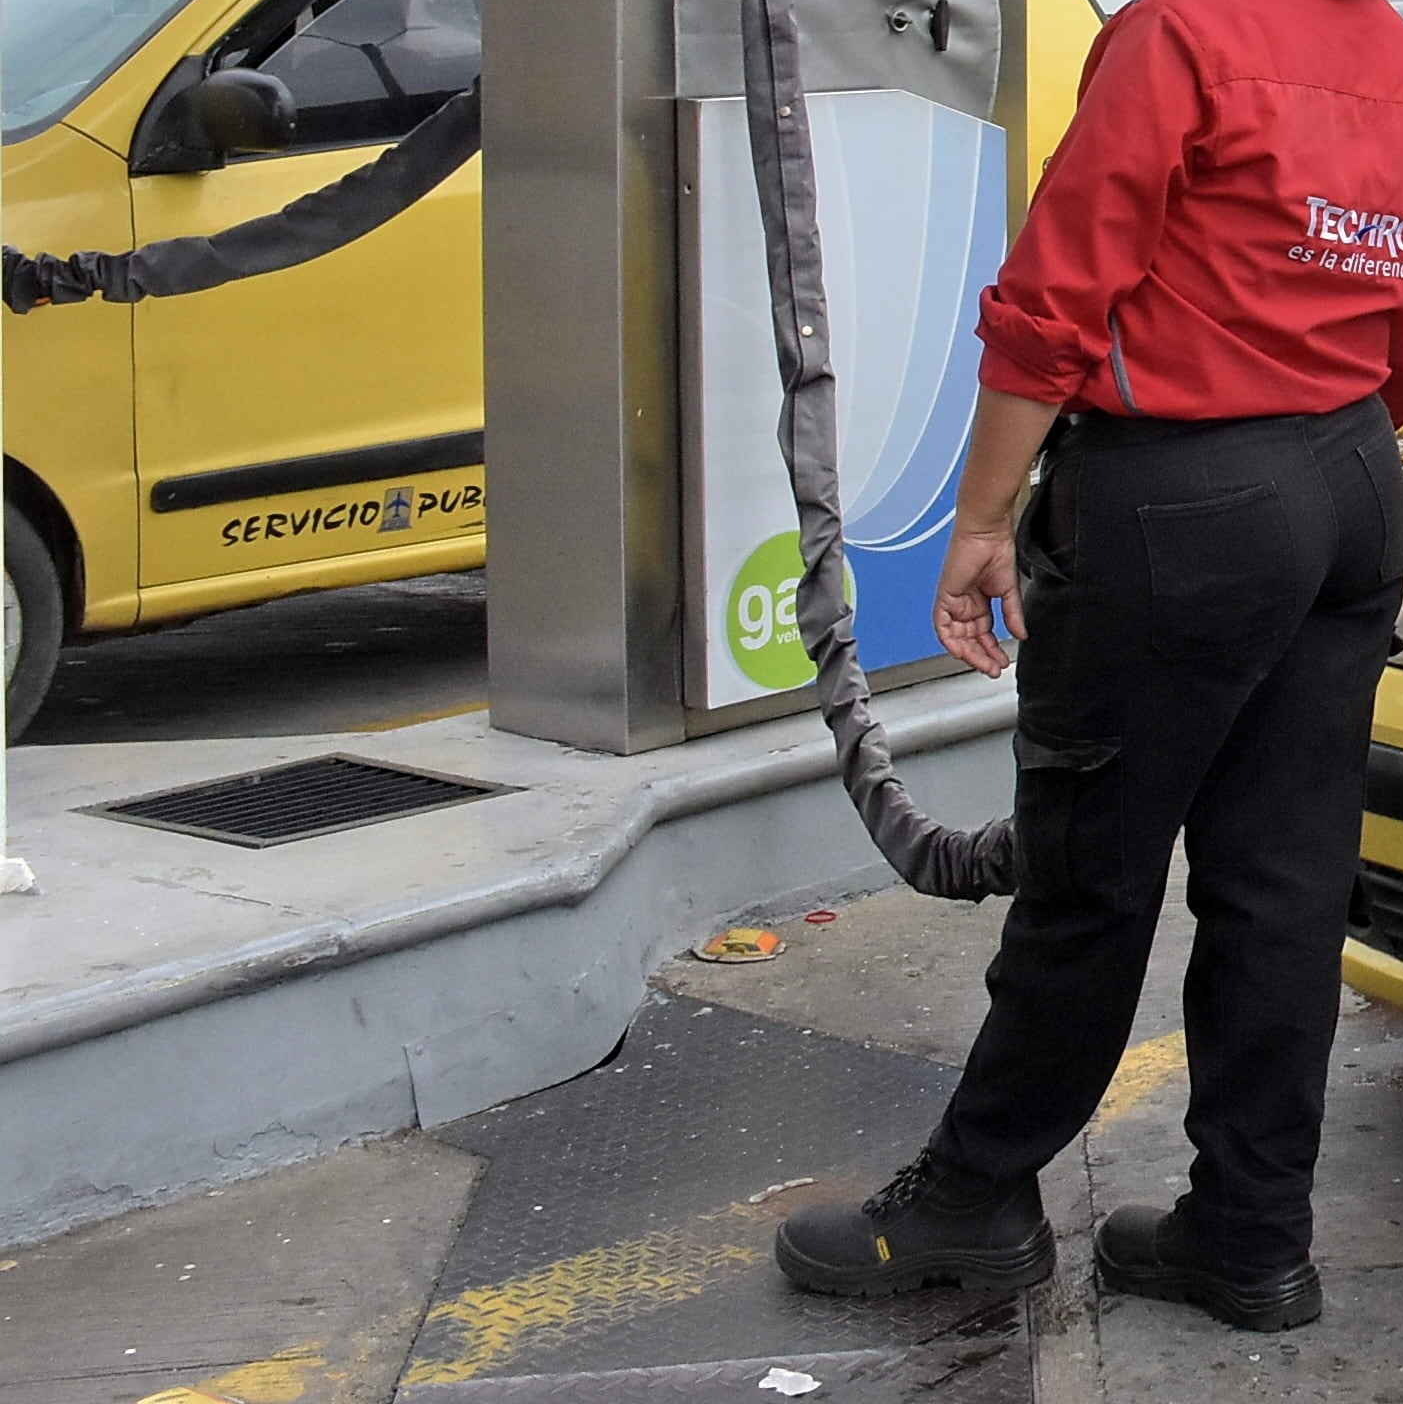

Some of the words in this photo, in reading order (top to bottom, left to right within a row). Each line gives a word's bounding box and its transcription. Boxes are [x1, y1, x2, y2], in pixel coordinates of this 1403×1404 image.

[1288, 244, 1312, 263] es
[1320, 251, 1337, 270] la
[222, 500, 381, 547] SERVICIO
[417, 484, 485, 519] PUB
